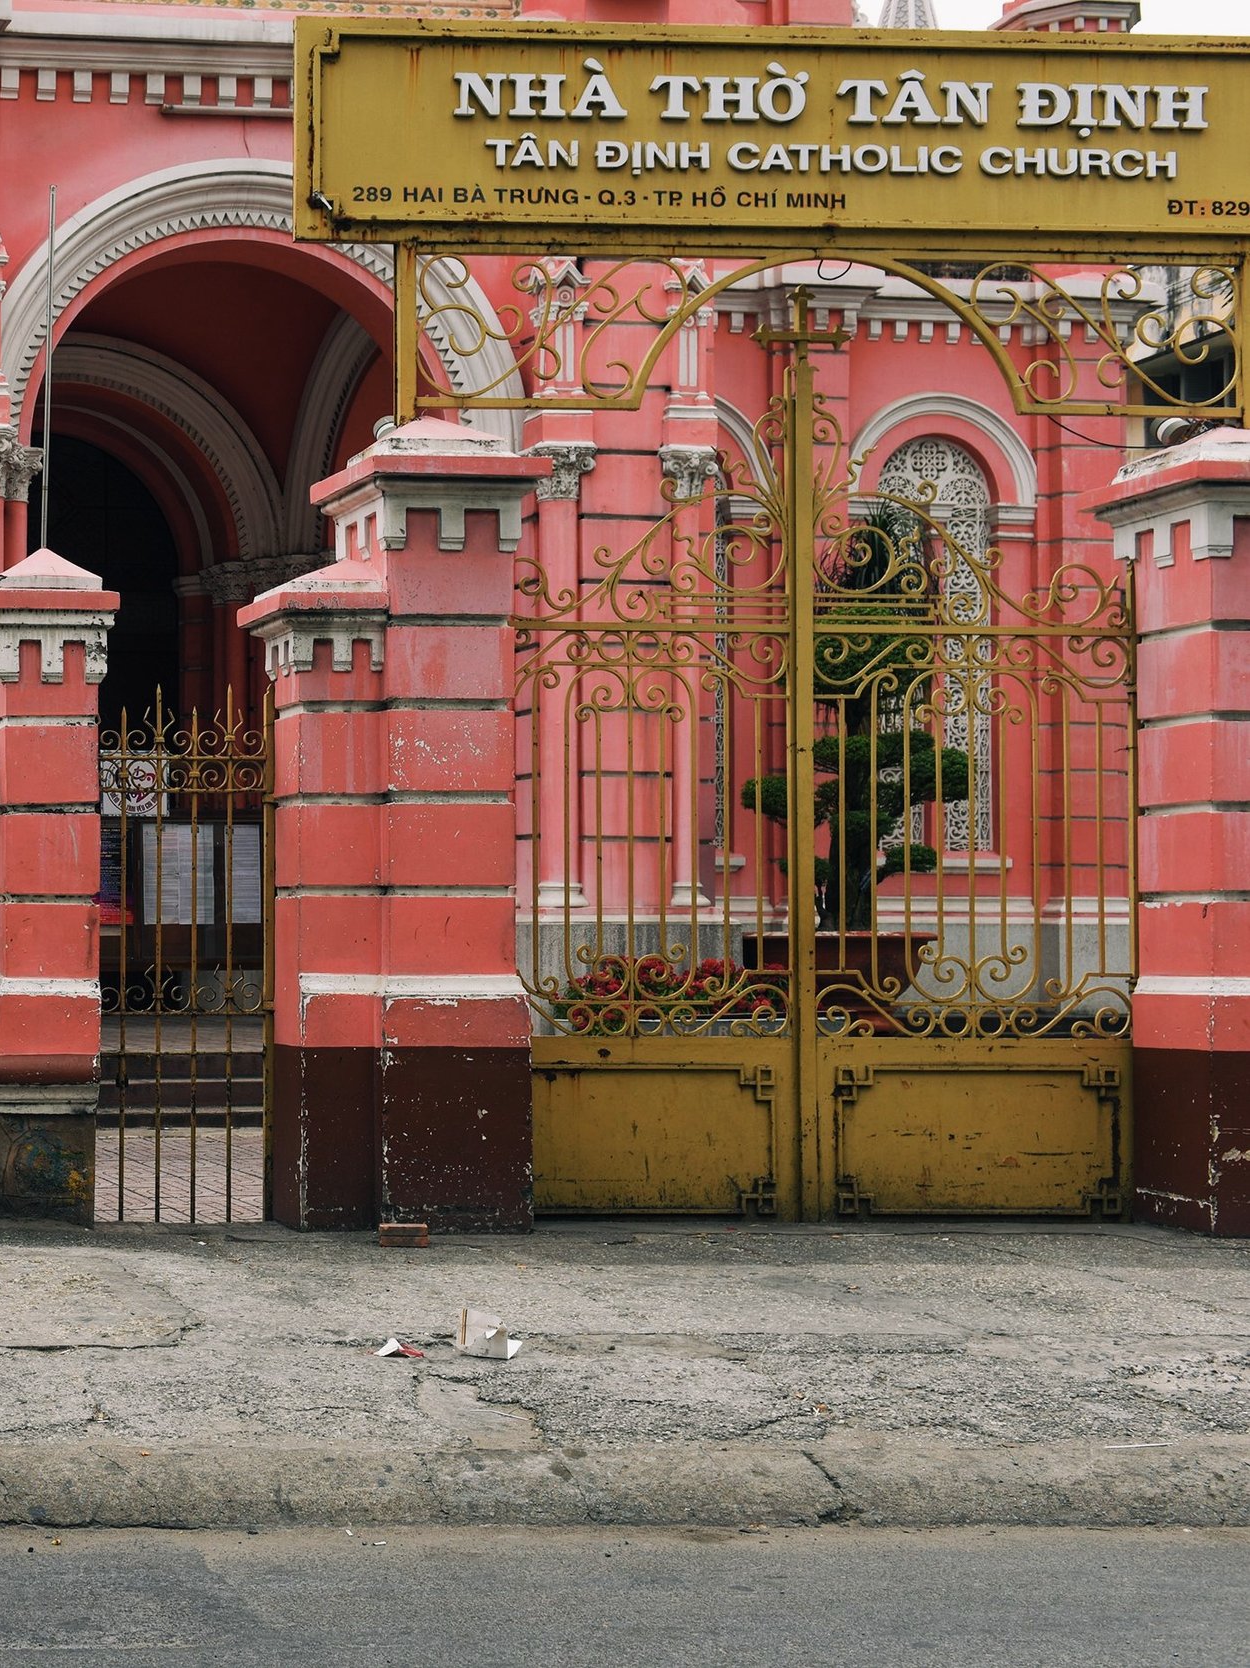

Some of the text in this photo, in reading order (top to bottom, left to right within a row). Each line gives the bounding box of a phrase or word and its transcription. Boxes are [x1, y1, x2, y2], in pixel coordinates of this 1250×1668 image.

[453, 57, 1209, 137] NHÀ THỜ TÂN ĐỊNH
[485, 132, 1177, 178] TÂN ĐỊNH CATHOLIC CHURCH
[352, 186, 392, 202] 289
[403, 186, 443, 203] HAI
[453, 183, 486, 203] BÀ
[493, 186, 579, 205] TRƯNG
[692, 185, 727, 208] HỒ
[736, 188, 777, 208] CHÍ
[786, 192, 846, 210] MINH
